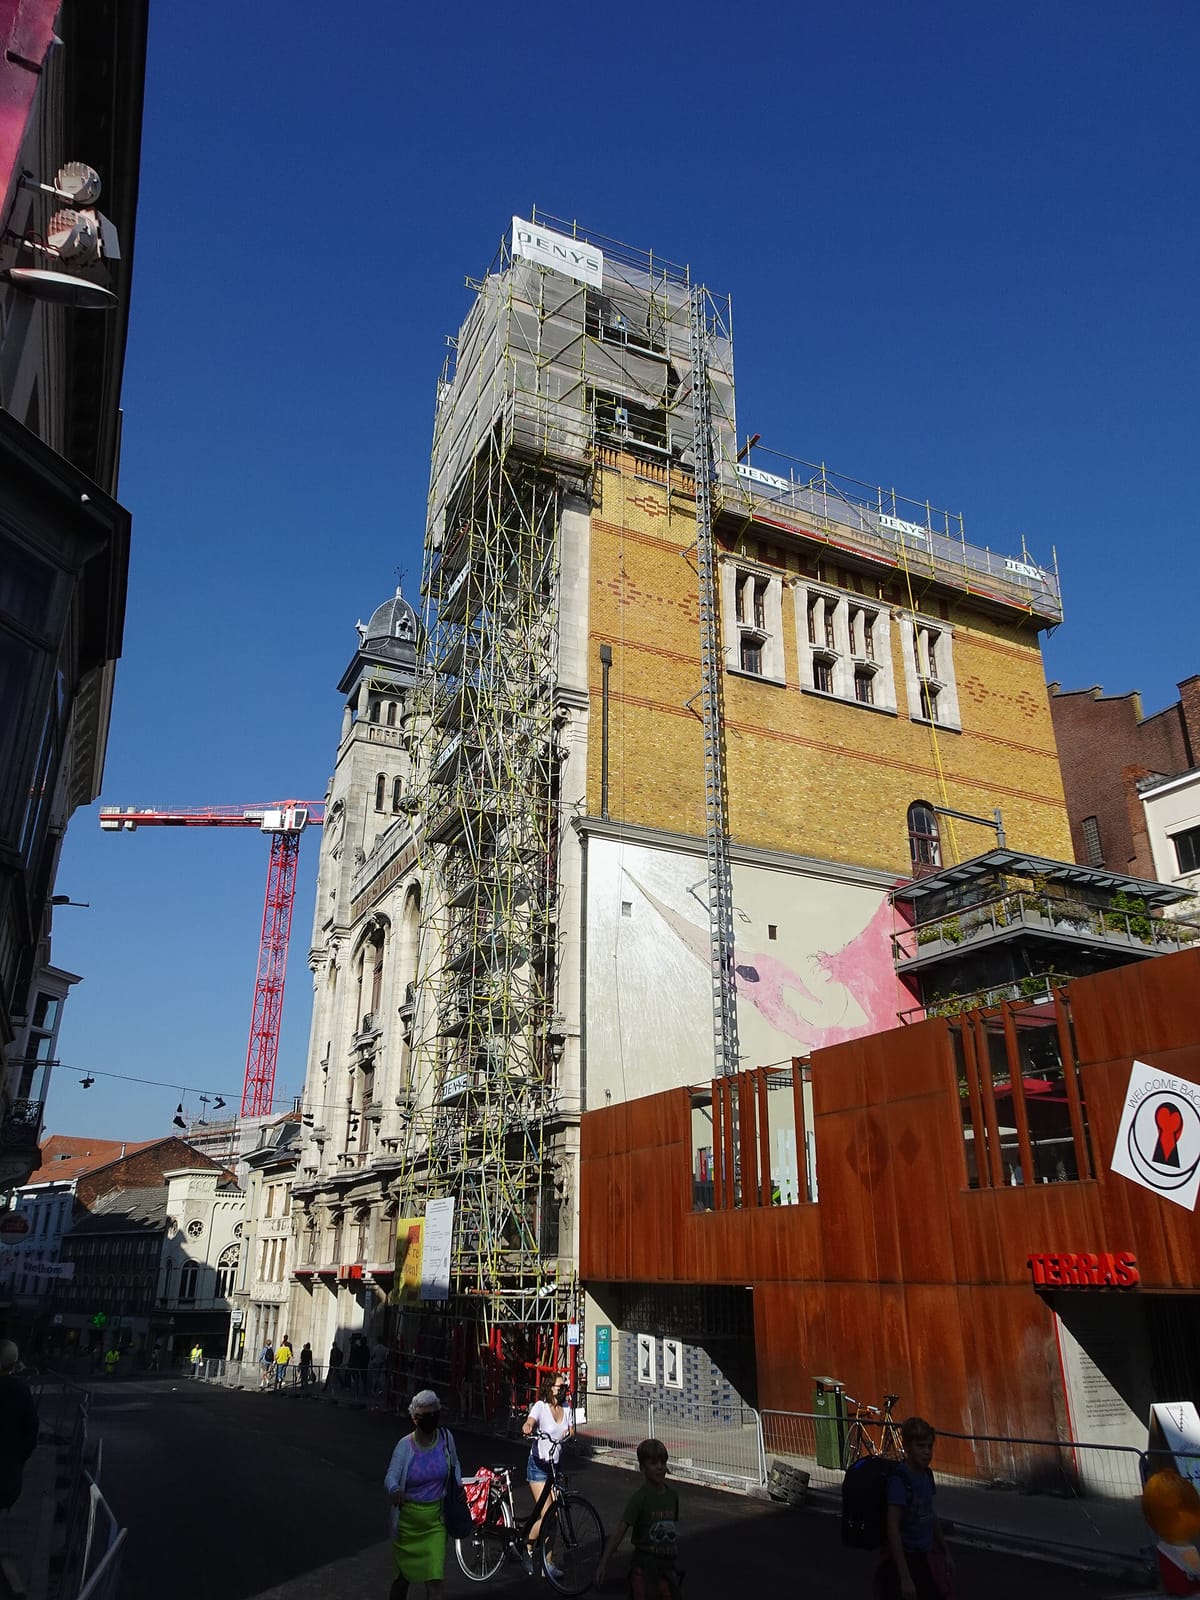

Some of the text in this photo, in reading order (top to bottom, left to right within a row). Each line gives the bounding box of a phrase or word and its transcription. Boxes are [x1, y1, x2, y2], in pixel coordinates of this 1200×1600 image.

[517, 231, 599, 272] DENYS
[737, 465, 789, 489] DENYS
[880, 516, 926, 537] DENYS
[1128, 1078, 1200, 1110] WELCOME BAC
[1027, 1251, 1140, 1287] TERRAS
